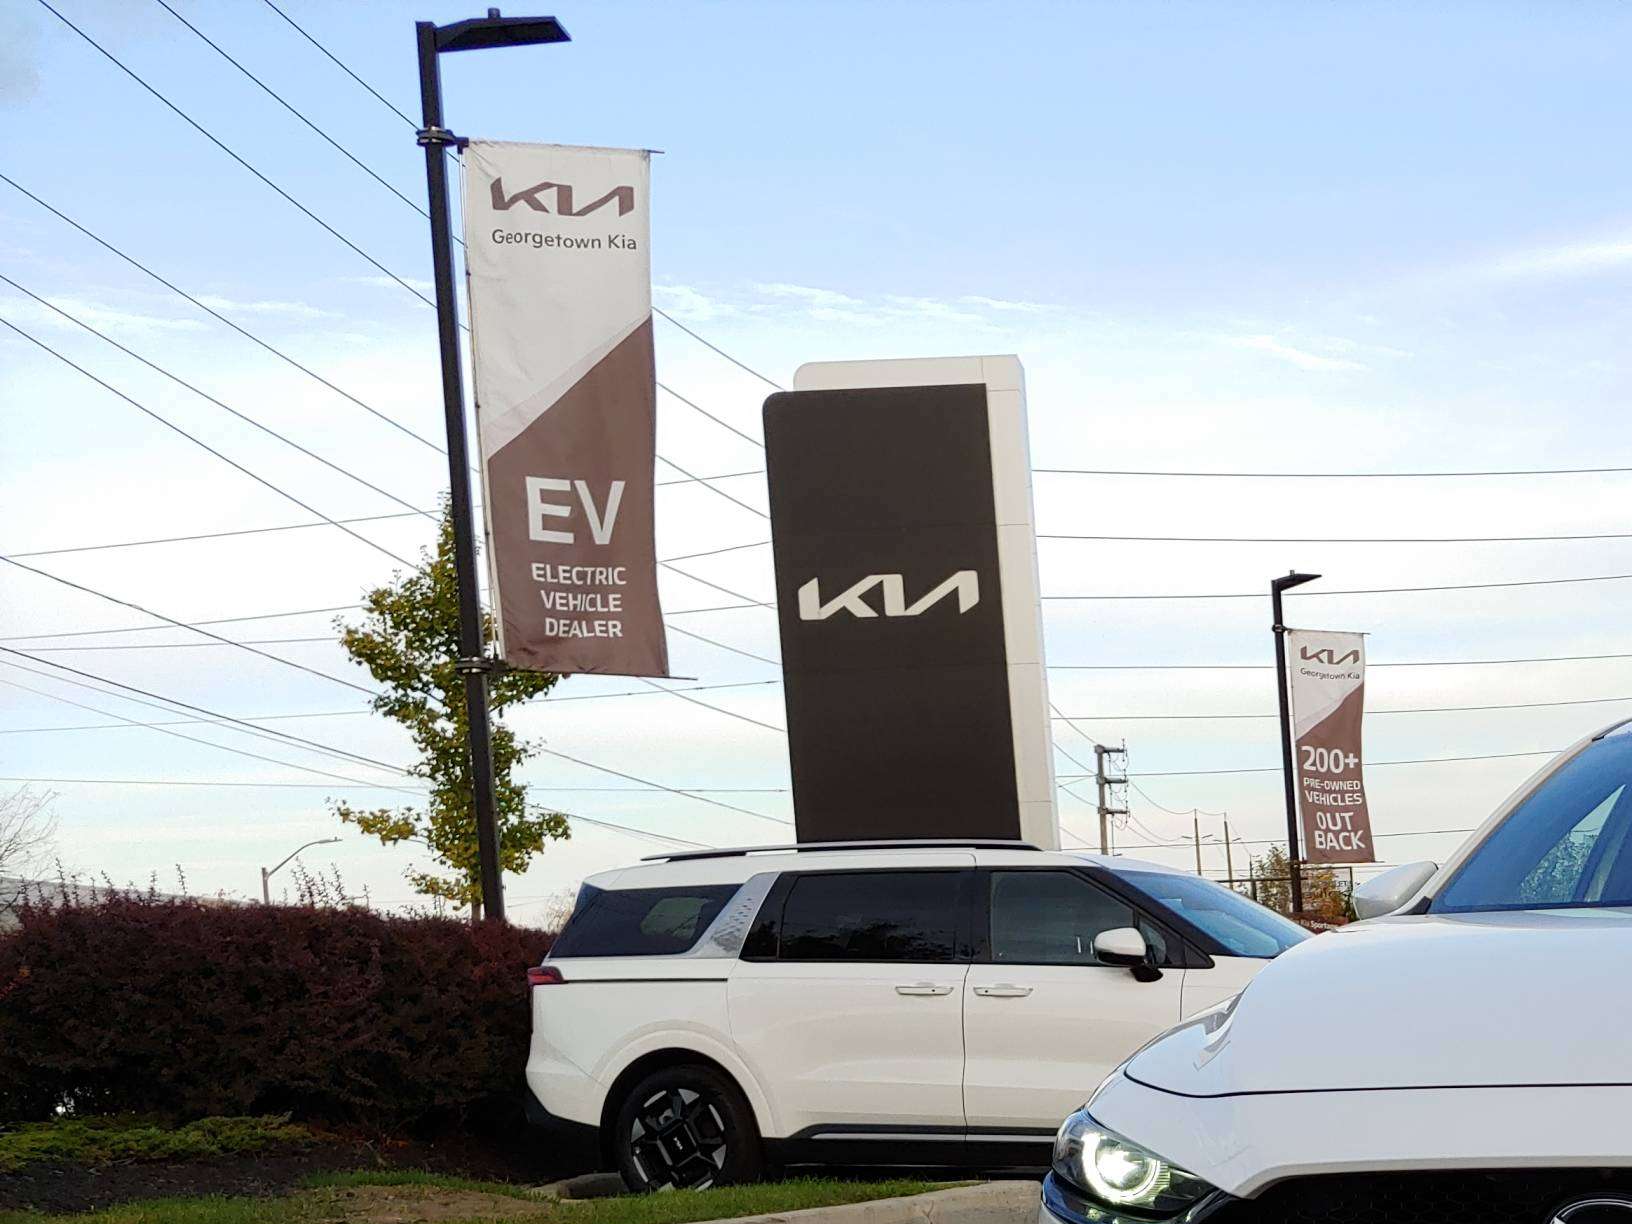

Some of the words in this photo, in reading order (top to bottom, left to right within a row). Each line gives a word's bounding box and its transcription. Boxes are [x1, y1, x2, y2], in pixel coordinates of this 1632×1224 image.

[490, 176, 634, 217] KIA
[491, 229, 602, 250] Georgetown
[607, 233, 637, 251] Kia
[525, 476, 626, 545] EV
[531, 563, 627, 585] ELECTRIC
[540, 589, 622, 612] VEHICLE
[798, 570, 979, 620] KIA
[545, 617, 622, 638] DEALER
[1300, 645, 1360, 665] KIA
[1300, 667, 1346, 680] Georgetown
[1347, 671, 1360, 680] Kia
[1301, 746, 1359, 774] 200+
[1303, 777, 1361, 790] PRE-OWNED
[1304, 790, 1362, 806] VEHICLES
[1316, 811, 1354, 831] OUT
[1314, 830, 1366, 851] BACK
